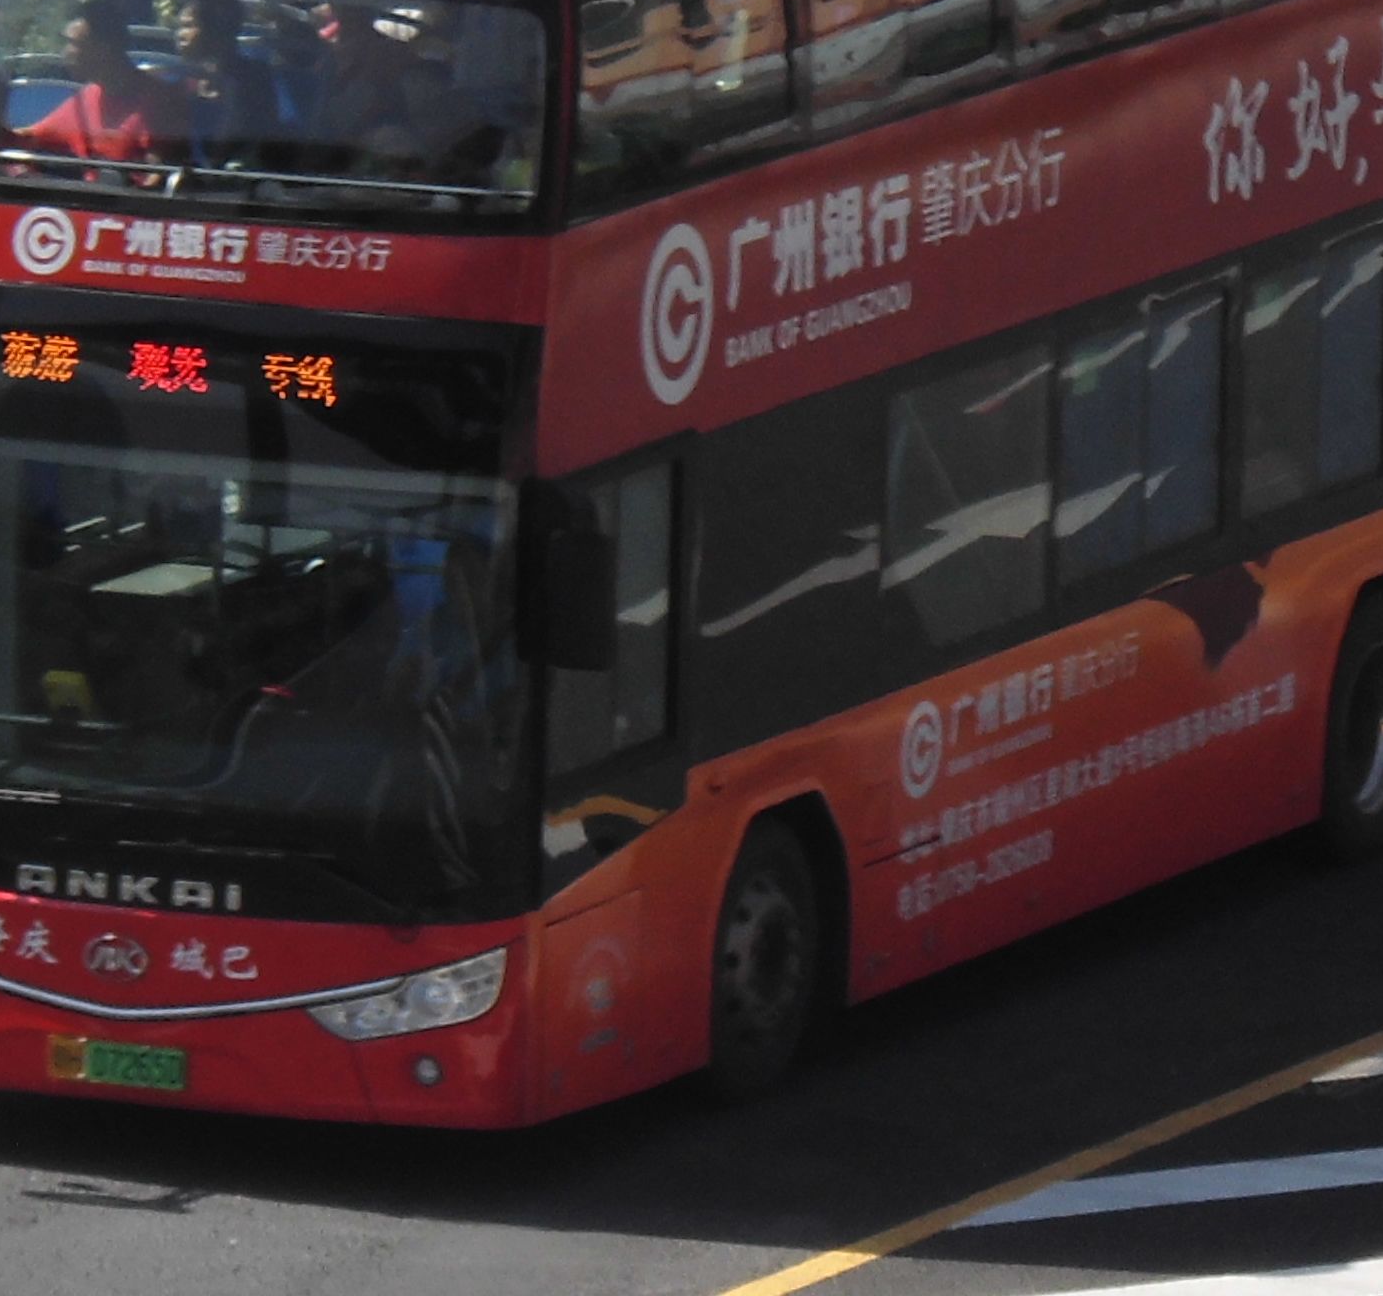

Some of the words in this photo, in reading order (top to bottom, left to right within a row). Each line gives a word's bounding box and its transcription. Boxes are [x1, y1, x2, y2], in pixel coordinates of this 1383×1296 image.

[84, 217, 251, 265] 广州银行
[255, 231, 393, 271] 肇庆分行
[727, 174, 912, 312] 广州银行
[921, 127, 1066, 245] 肇庆分行
[725, 330, 775, 368] BANK
[777, 316, 803, 349] OF
[803, 280, 913, 343] GUANGZHOU
[261, 354, 337, 407] 专线
[15, 863, 243, 912] ANKAI
